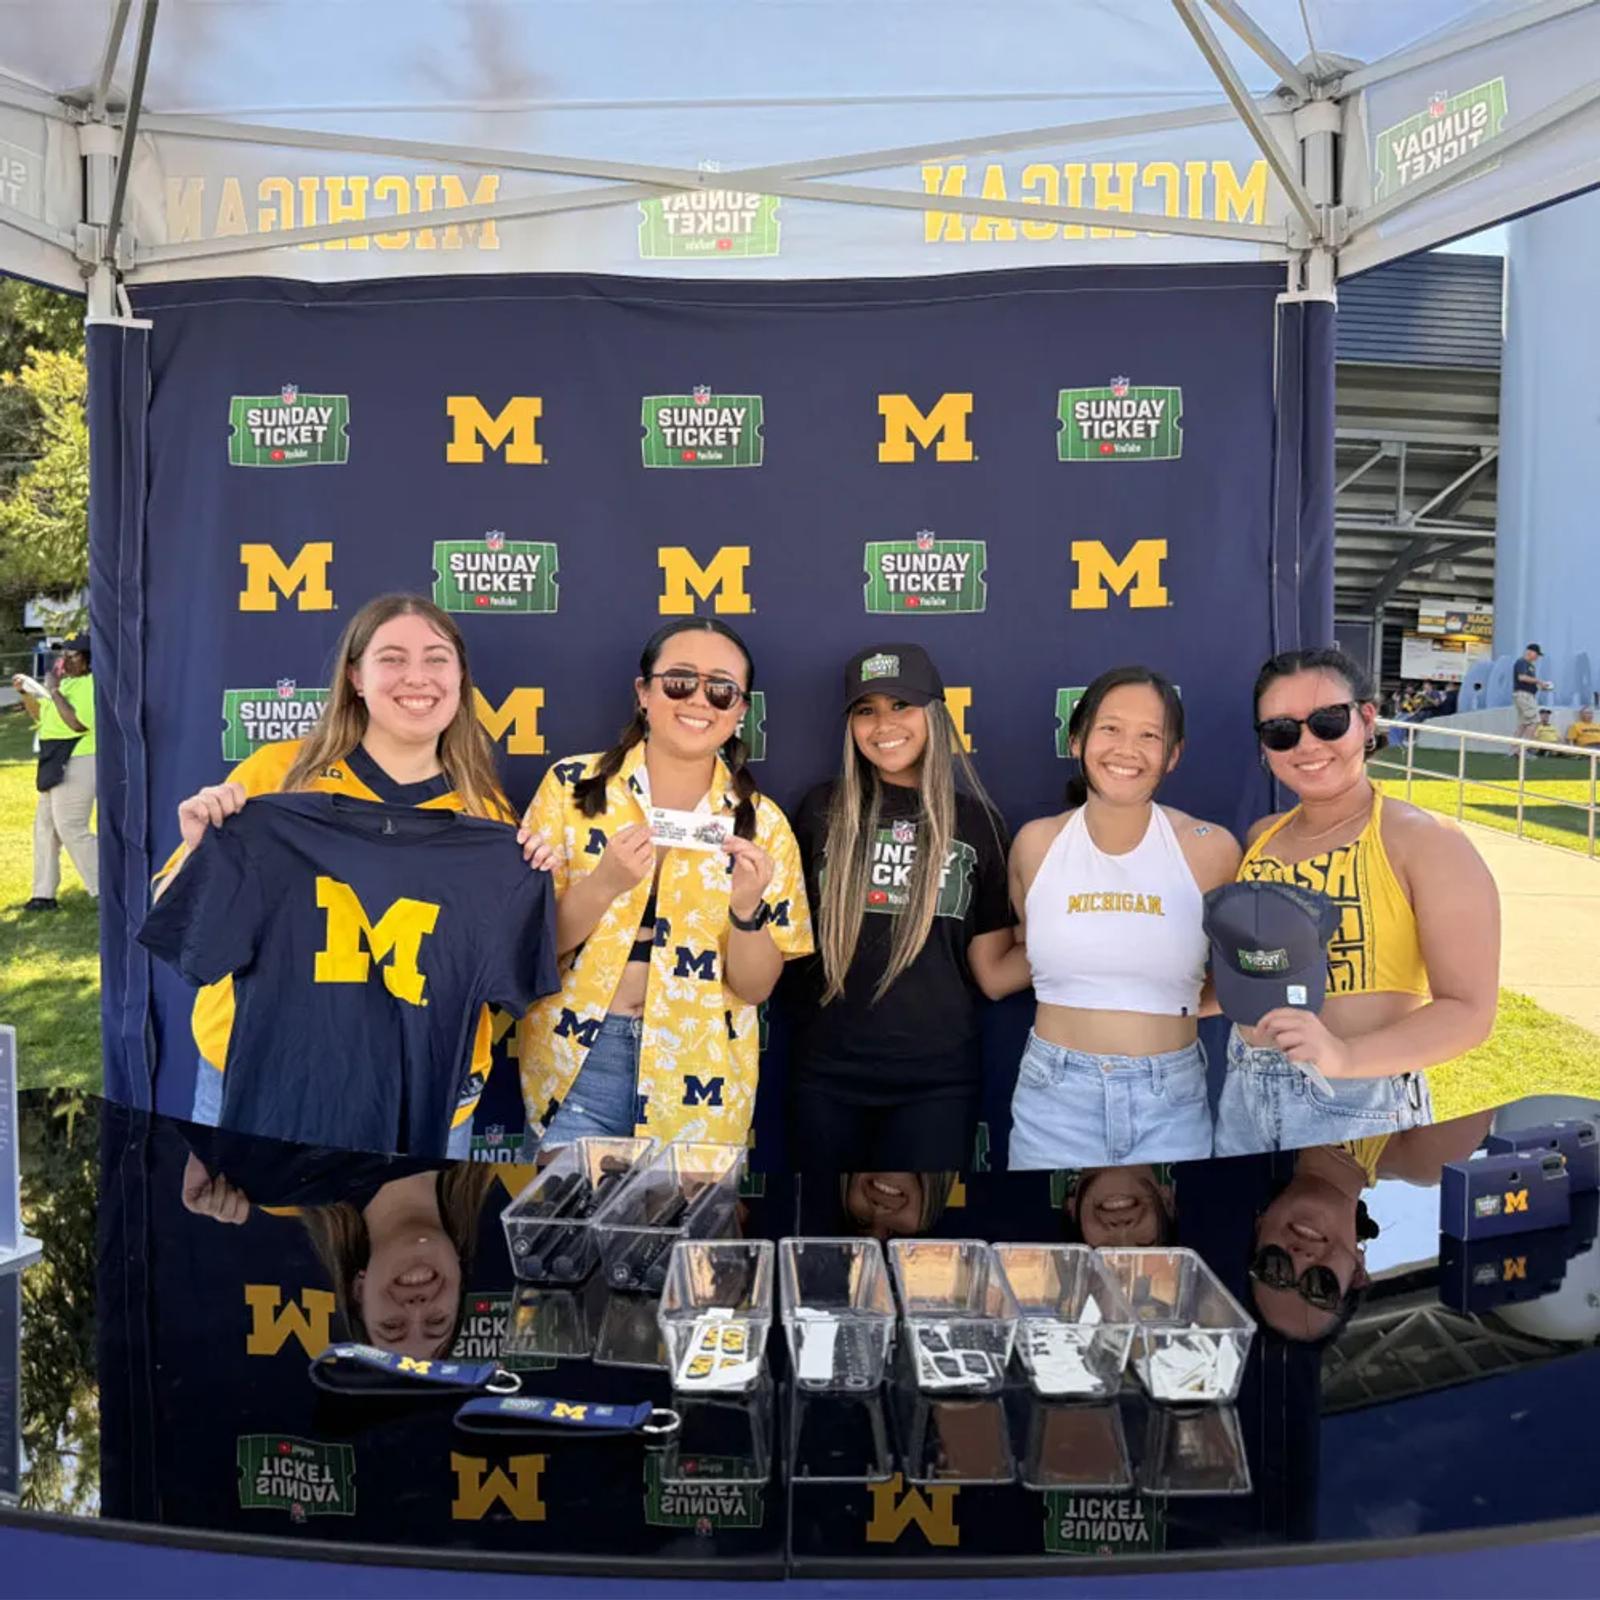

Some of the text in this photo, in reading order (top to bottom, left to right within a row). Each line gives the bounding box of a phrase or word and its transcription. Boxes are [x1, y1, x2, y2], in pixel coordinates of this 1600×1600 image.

[247, 406, 333, 427] SUNDAY
[658, 407, 747, 428] SUNDAY
[1075, 398, 1166, 419] SUNDAY
[251, 425, 328, 447] TICKET
[446, 396, 543, 464] M
[661, 427, 743, 447] TICKET
[878, 392, 974, 464] M
[1078, 419, 1161, 440] TICKET
[450, 553, 541, 573] SUNDAY
[880, 552, 971, 573] SUNDAY
[239, 541, 334, 611] M
[453, 572, 537, 593] TICKET
[657, 546, 750, 615] M
[884, 572, 966, 593] TICKET
[1070, 539, 1167, 609] M
[240, 701, 328, 720] SUNDAY
[244, 721, 316, 740] TICKE
[1067, 891, 1164, 916] MICHIGAN
[313, 876, 441, 1006] M
[674, 946, 717, 981] M
[682, 1074, 725, 1107] M
[1504, 1189, 1528, 1214] M
